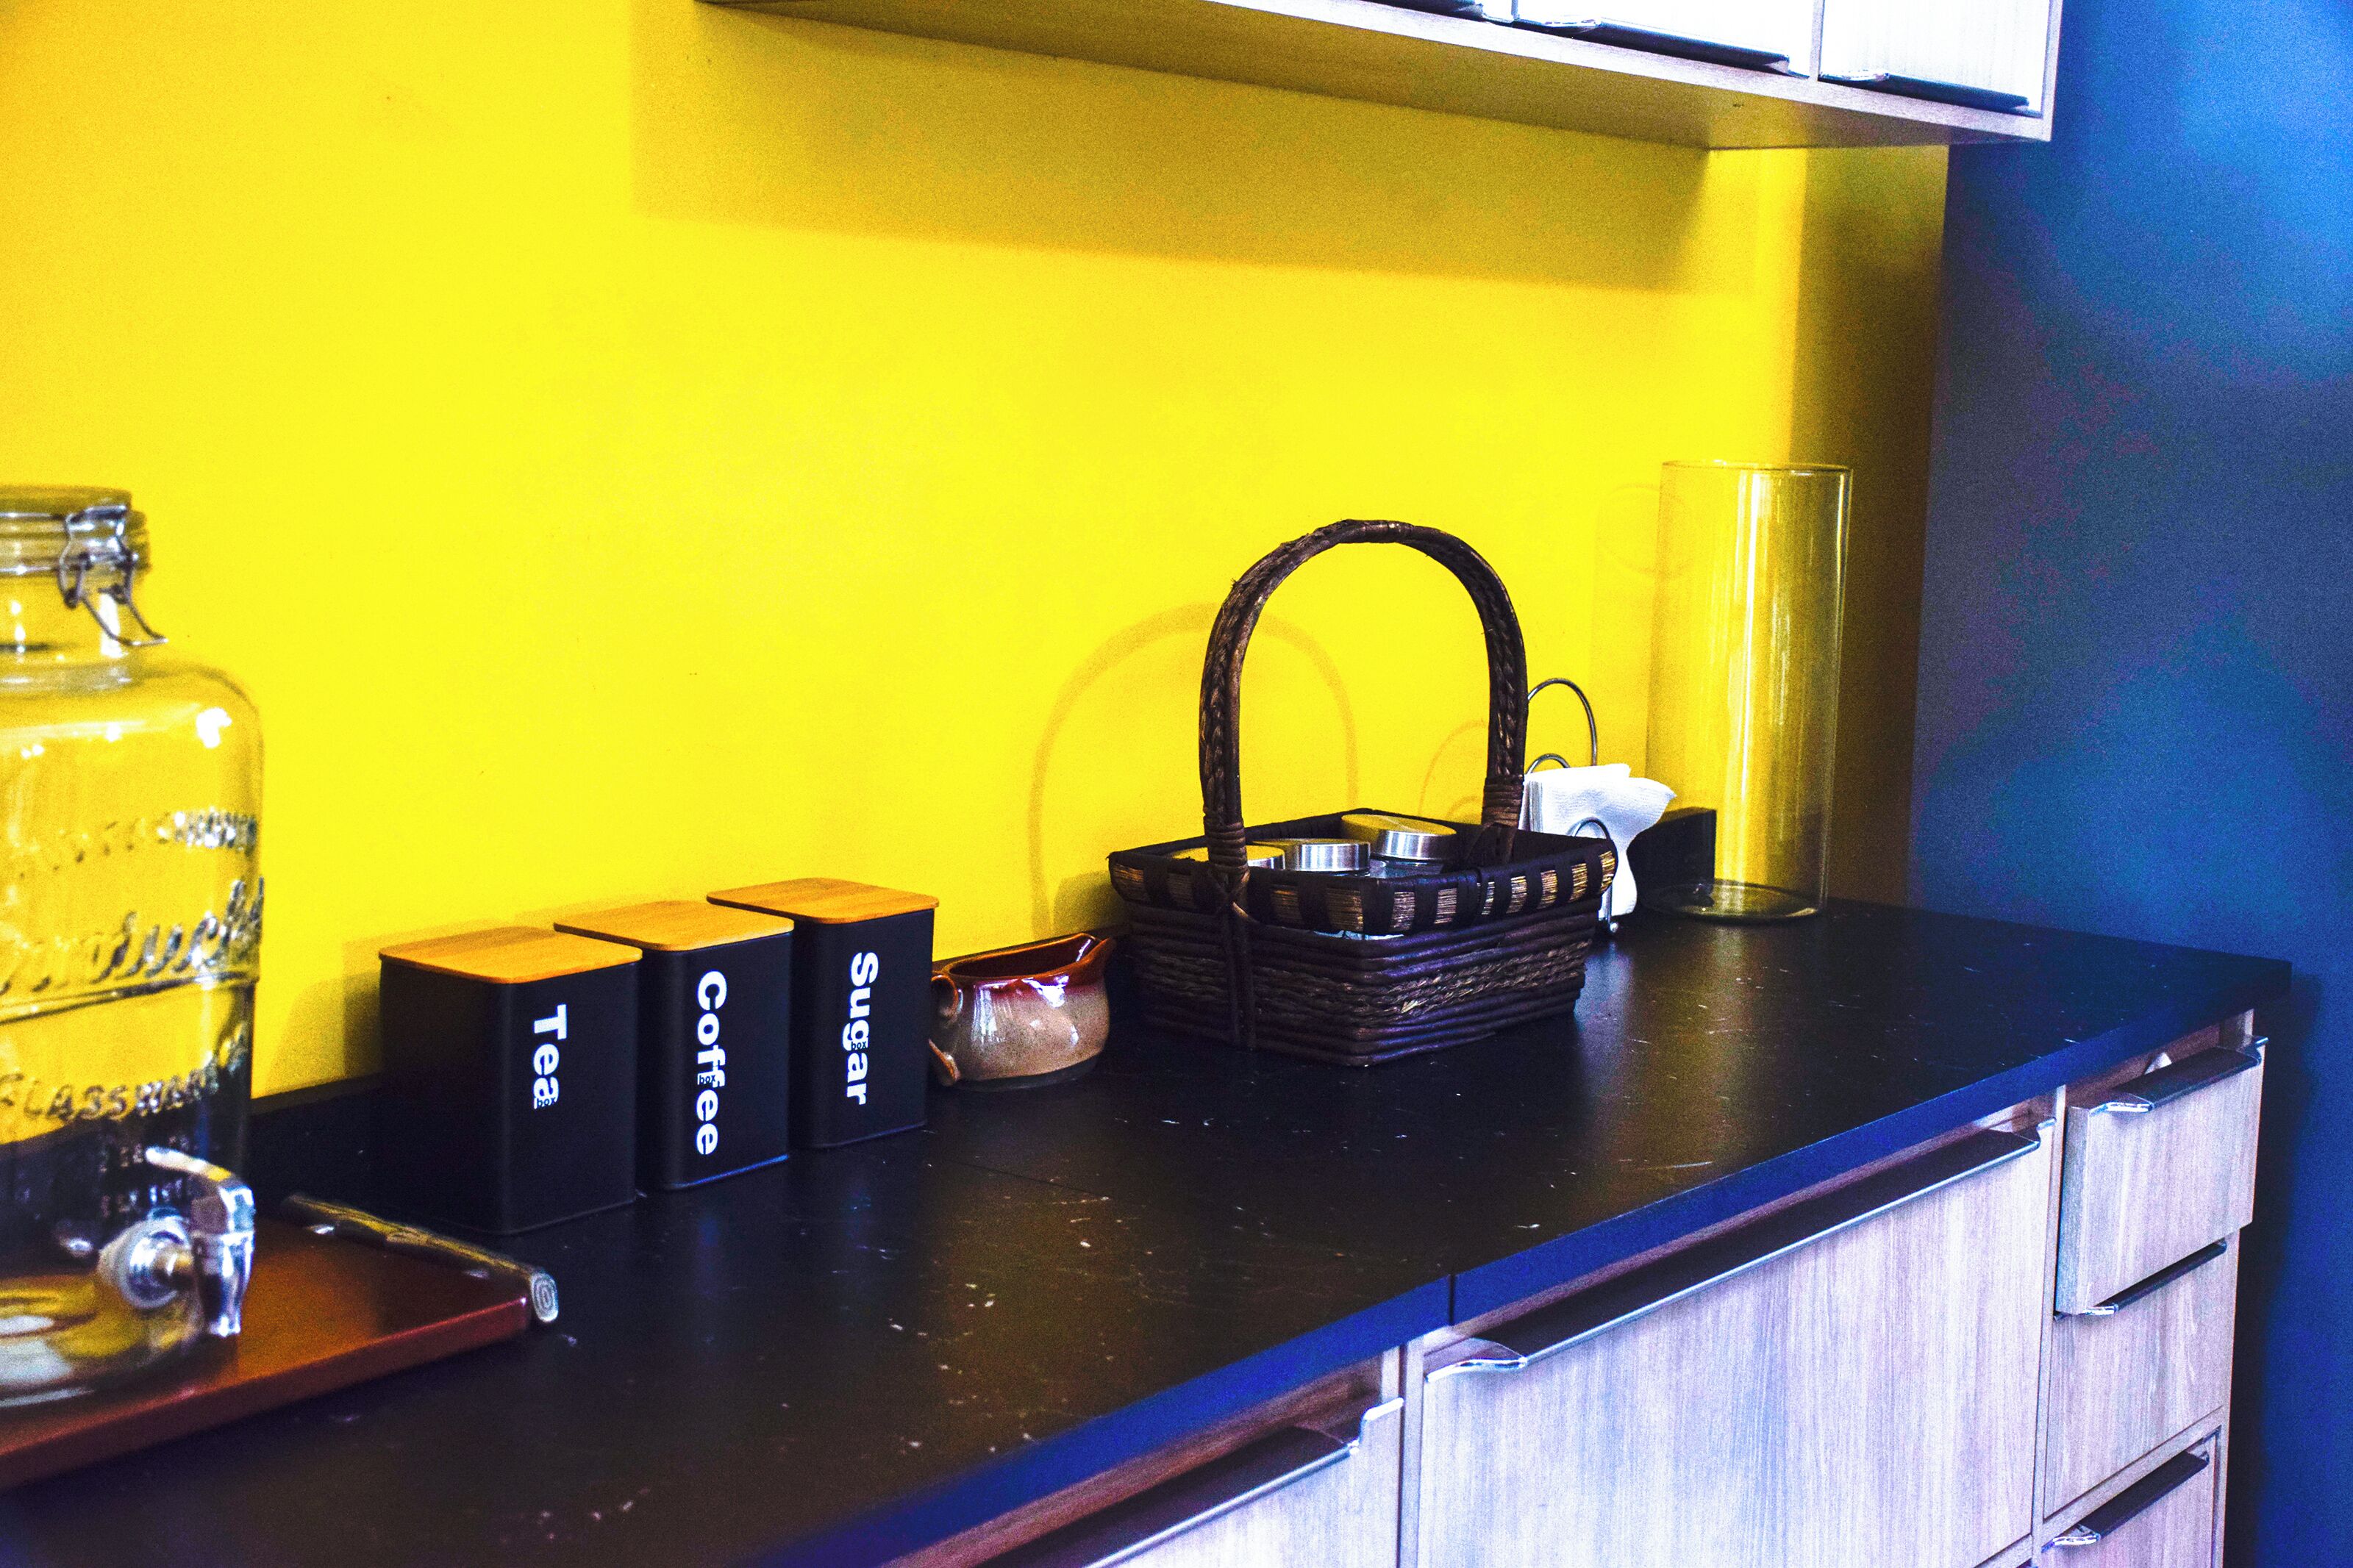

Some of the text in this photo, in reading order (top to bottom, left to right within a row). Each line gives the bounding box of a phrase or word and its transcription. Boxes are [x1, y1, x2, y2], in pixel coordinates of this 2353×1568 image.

[534, 1004, 567, 1109] Tea
[843, 952, 879, 1105] Sugar
[851, 1041, 867, 1050] box
[697, 970, 727, 1155] Coffee
[699, 1074, 716, 1084] box
[536, 1098, 556, 1109] box
